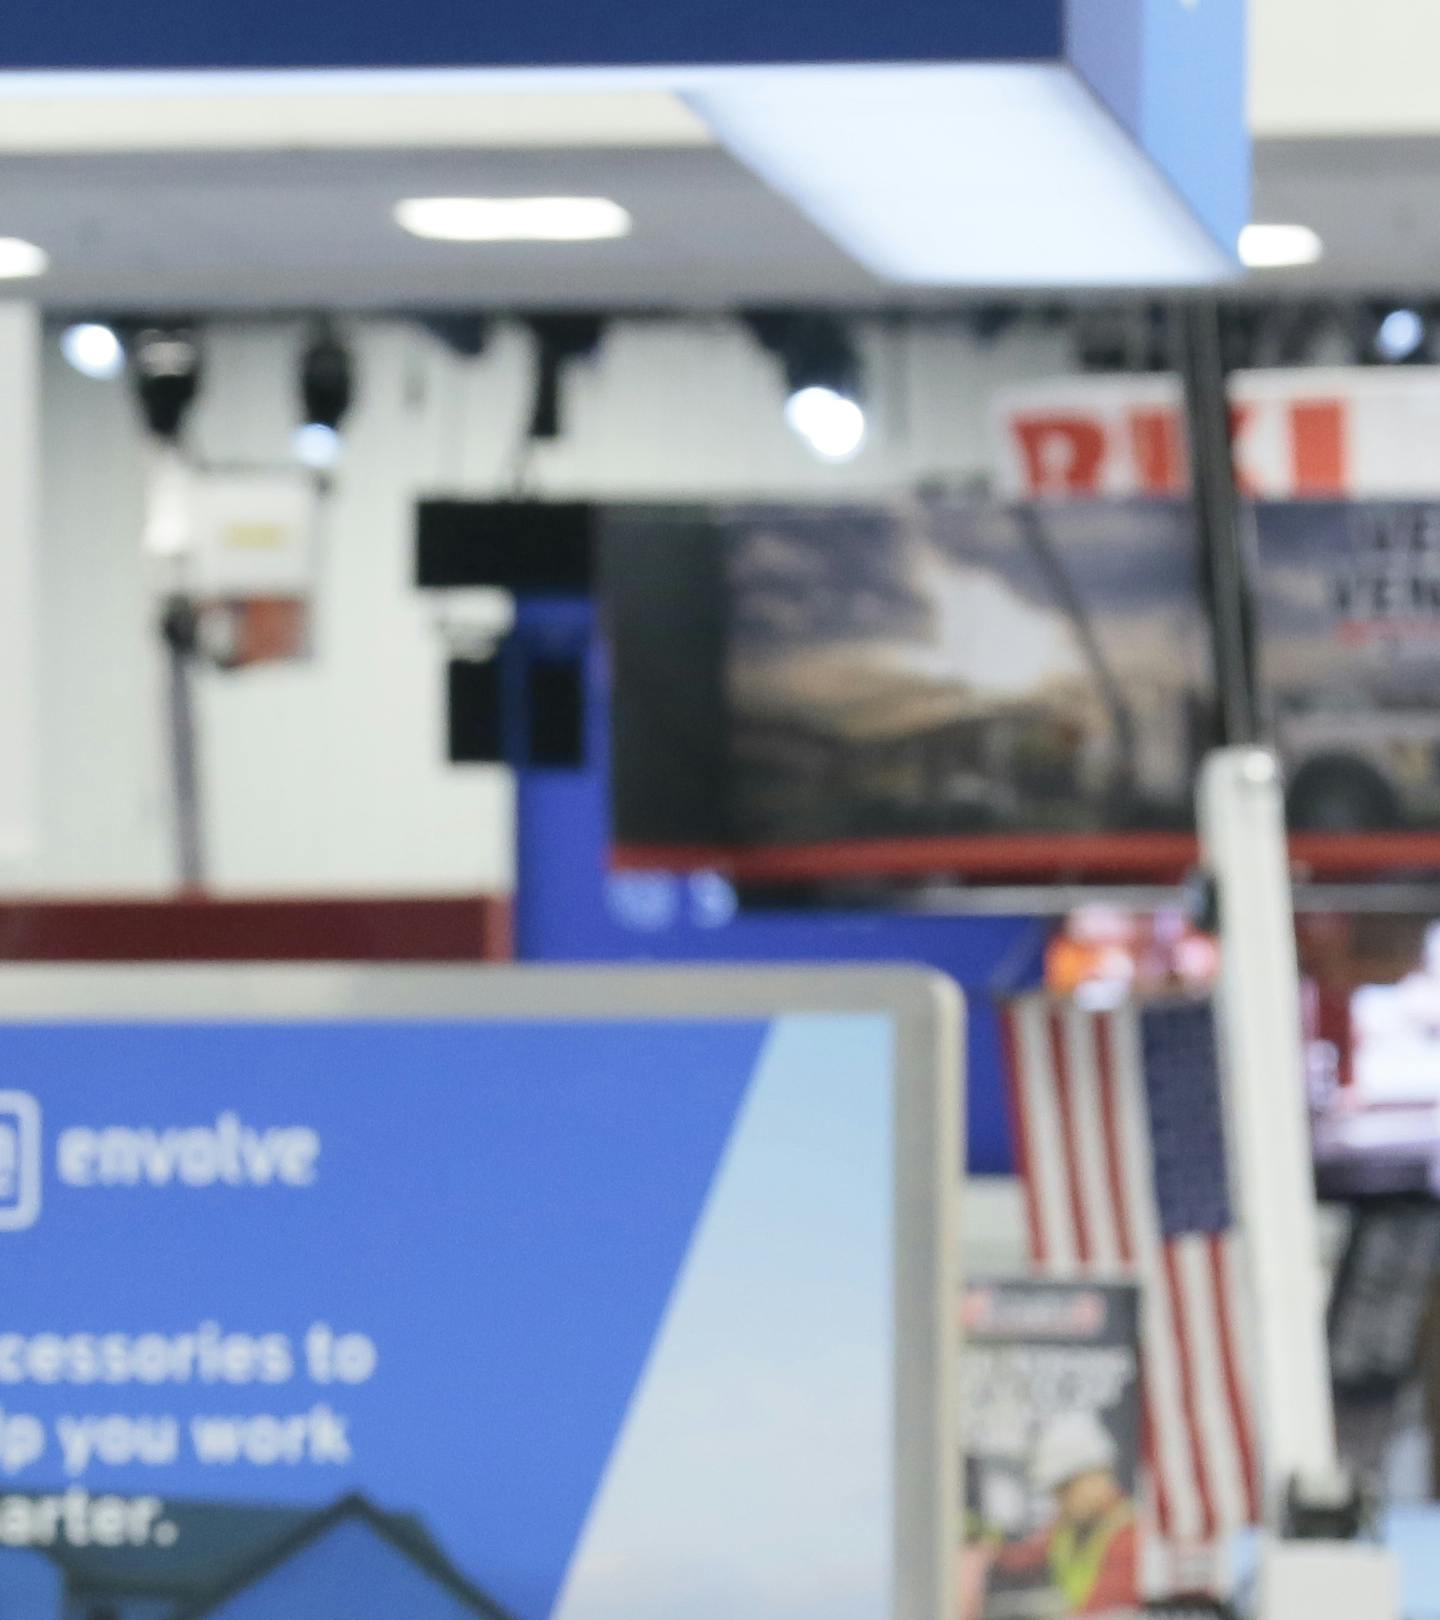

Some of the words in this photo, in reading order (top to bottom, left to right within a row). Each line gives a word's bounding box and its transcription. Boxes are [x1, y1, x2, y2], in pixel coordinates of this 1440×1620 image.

[58, 1111, 319, 1187] envolve
[306, 1321, 377, 1384] to
[58, 1413, 179, 1474] you
[191, 1403, 351, 1464] work
